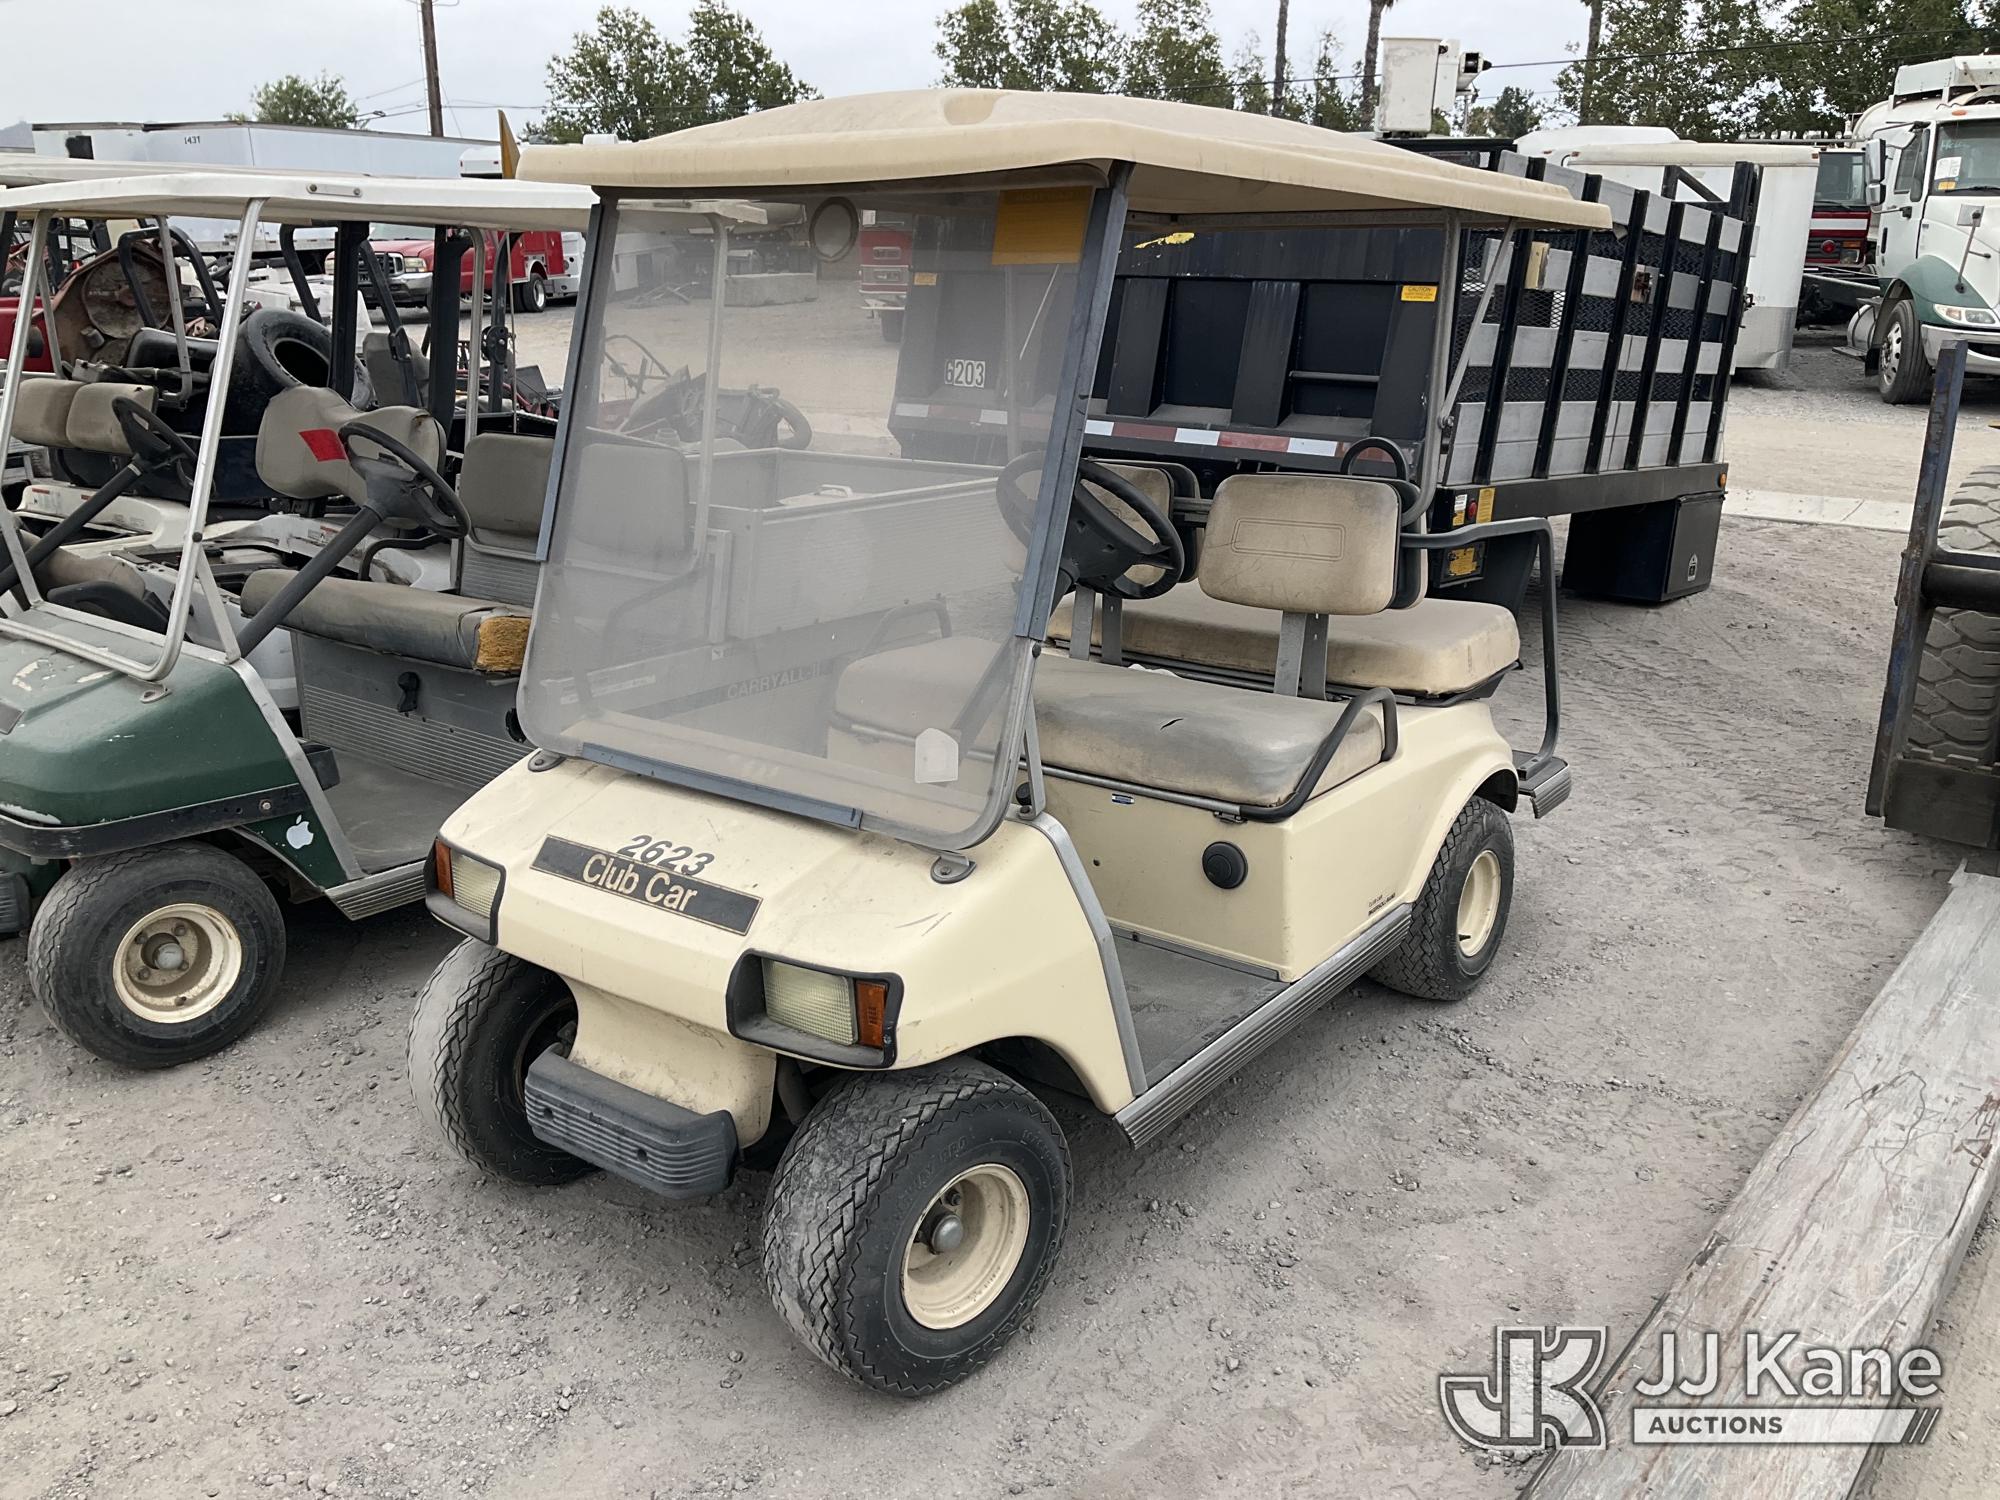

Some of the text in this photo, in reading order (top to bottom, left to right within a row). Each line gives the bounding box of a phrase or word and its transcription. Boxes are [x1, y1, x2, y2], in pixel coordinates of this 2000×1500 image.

[945, 360, 985, 386] 6203
[617, 835, 715, 876] 2623
[582, 853, 698, 911] Club Car
